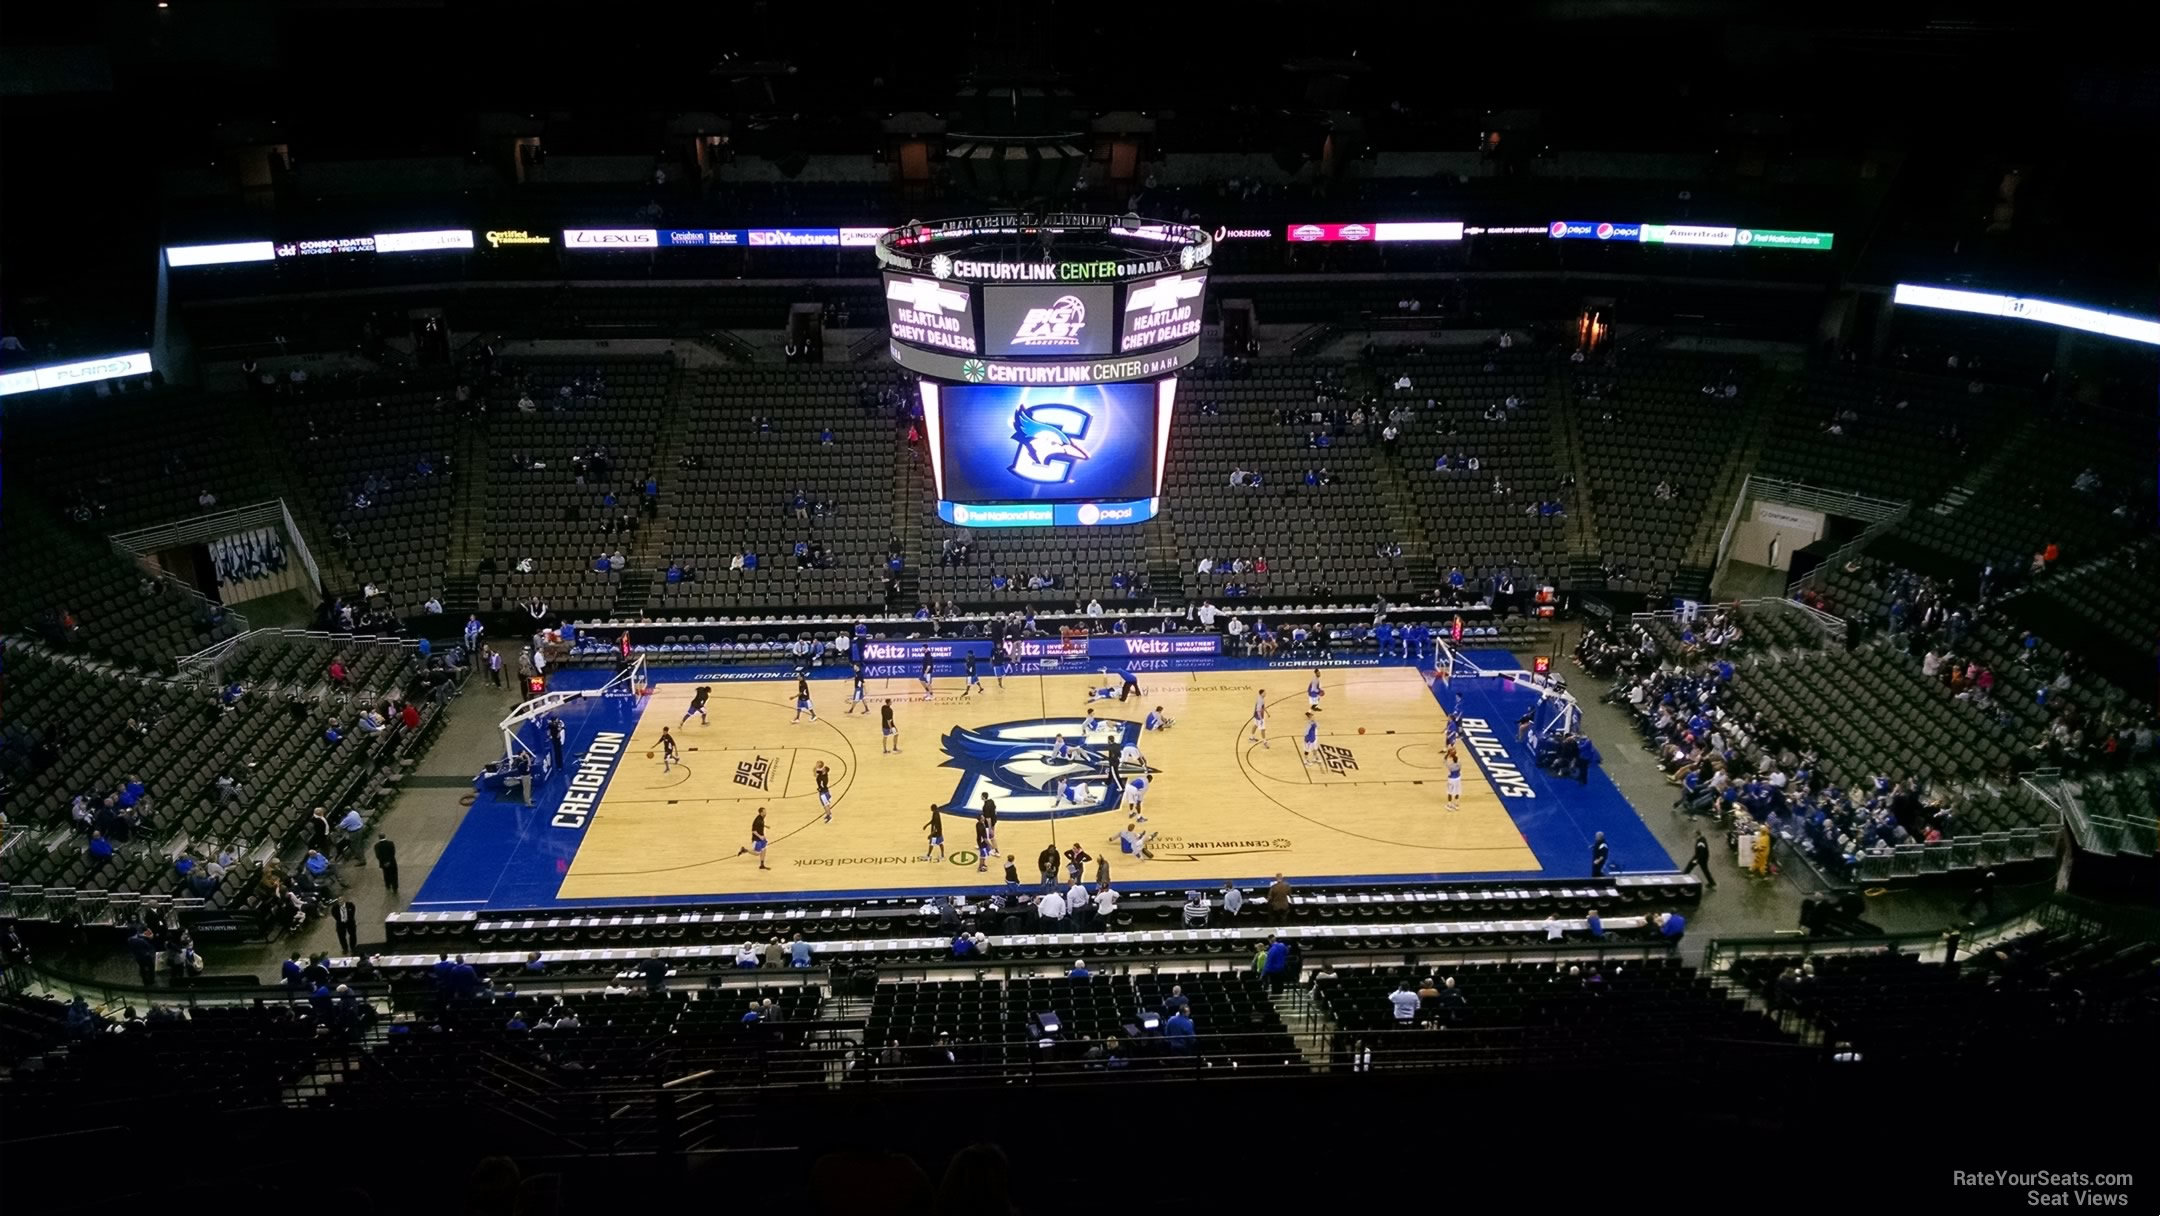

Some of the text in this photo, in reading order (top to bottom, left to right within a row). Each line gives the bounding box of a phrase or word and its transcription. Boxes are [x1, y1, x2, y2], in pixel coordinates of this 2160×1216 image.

[486, 231, 527, 240] Certified
[671, 231, 704, 240] Creighton
[766, 230, 838, 244] DiVentures
[1567, 226, 1592, 234] pepsi
[1613, 228, 1638, 236] pepsi
[1669, 229, 1729, 238] Ameritrade
[300, 238, 374, 249] CONSOLIDATED
[593, 235, 650, 243] LEXUS
[953, 260, 1163, 280] CENTURYLINK CENTER OMAHA
[898, 308, 960, 332] HEARTLAND
[1024, 309, 1072, 323] BIG
[1134, 306, 1192, 330] HEARTLAND
[892, 322, 976, 352] CHEVY DEALERS
[1016, 323, 1085, 337] EAST
[1123, 319, 1202, 350] CHEVY DEALERS
[987, 356, 1178, 382] CENTURYLINK CENTER OMAHA
[1100, 507, 1132, 519] pepsi
[864, 644, 905, 659] Weitz
[1003, 641, 1040, 655] Witz
[1125, 639, 1169, 653] Weitz
[1320, 743, 1347, 777] EAST
[1336, 746, 1359, 771] BIG
[1461, 718, 1536, 798] BLUEJAYS
[733, 761, 752, 785] BIG
[748, 755, 768, 789] EAST
[551, 731, 625, 829] CREIGHTON
[1187, 840, 1270, 850] CENTURYLINK
[793, 859, 834, 867] Bank
[838, 856, 907, 866] National
